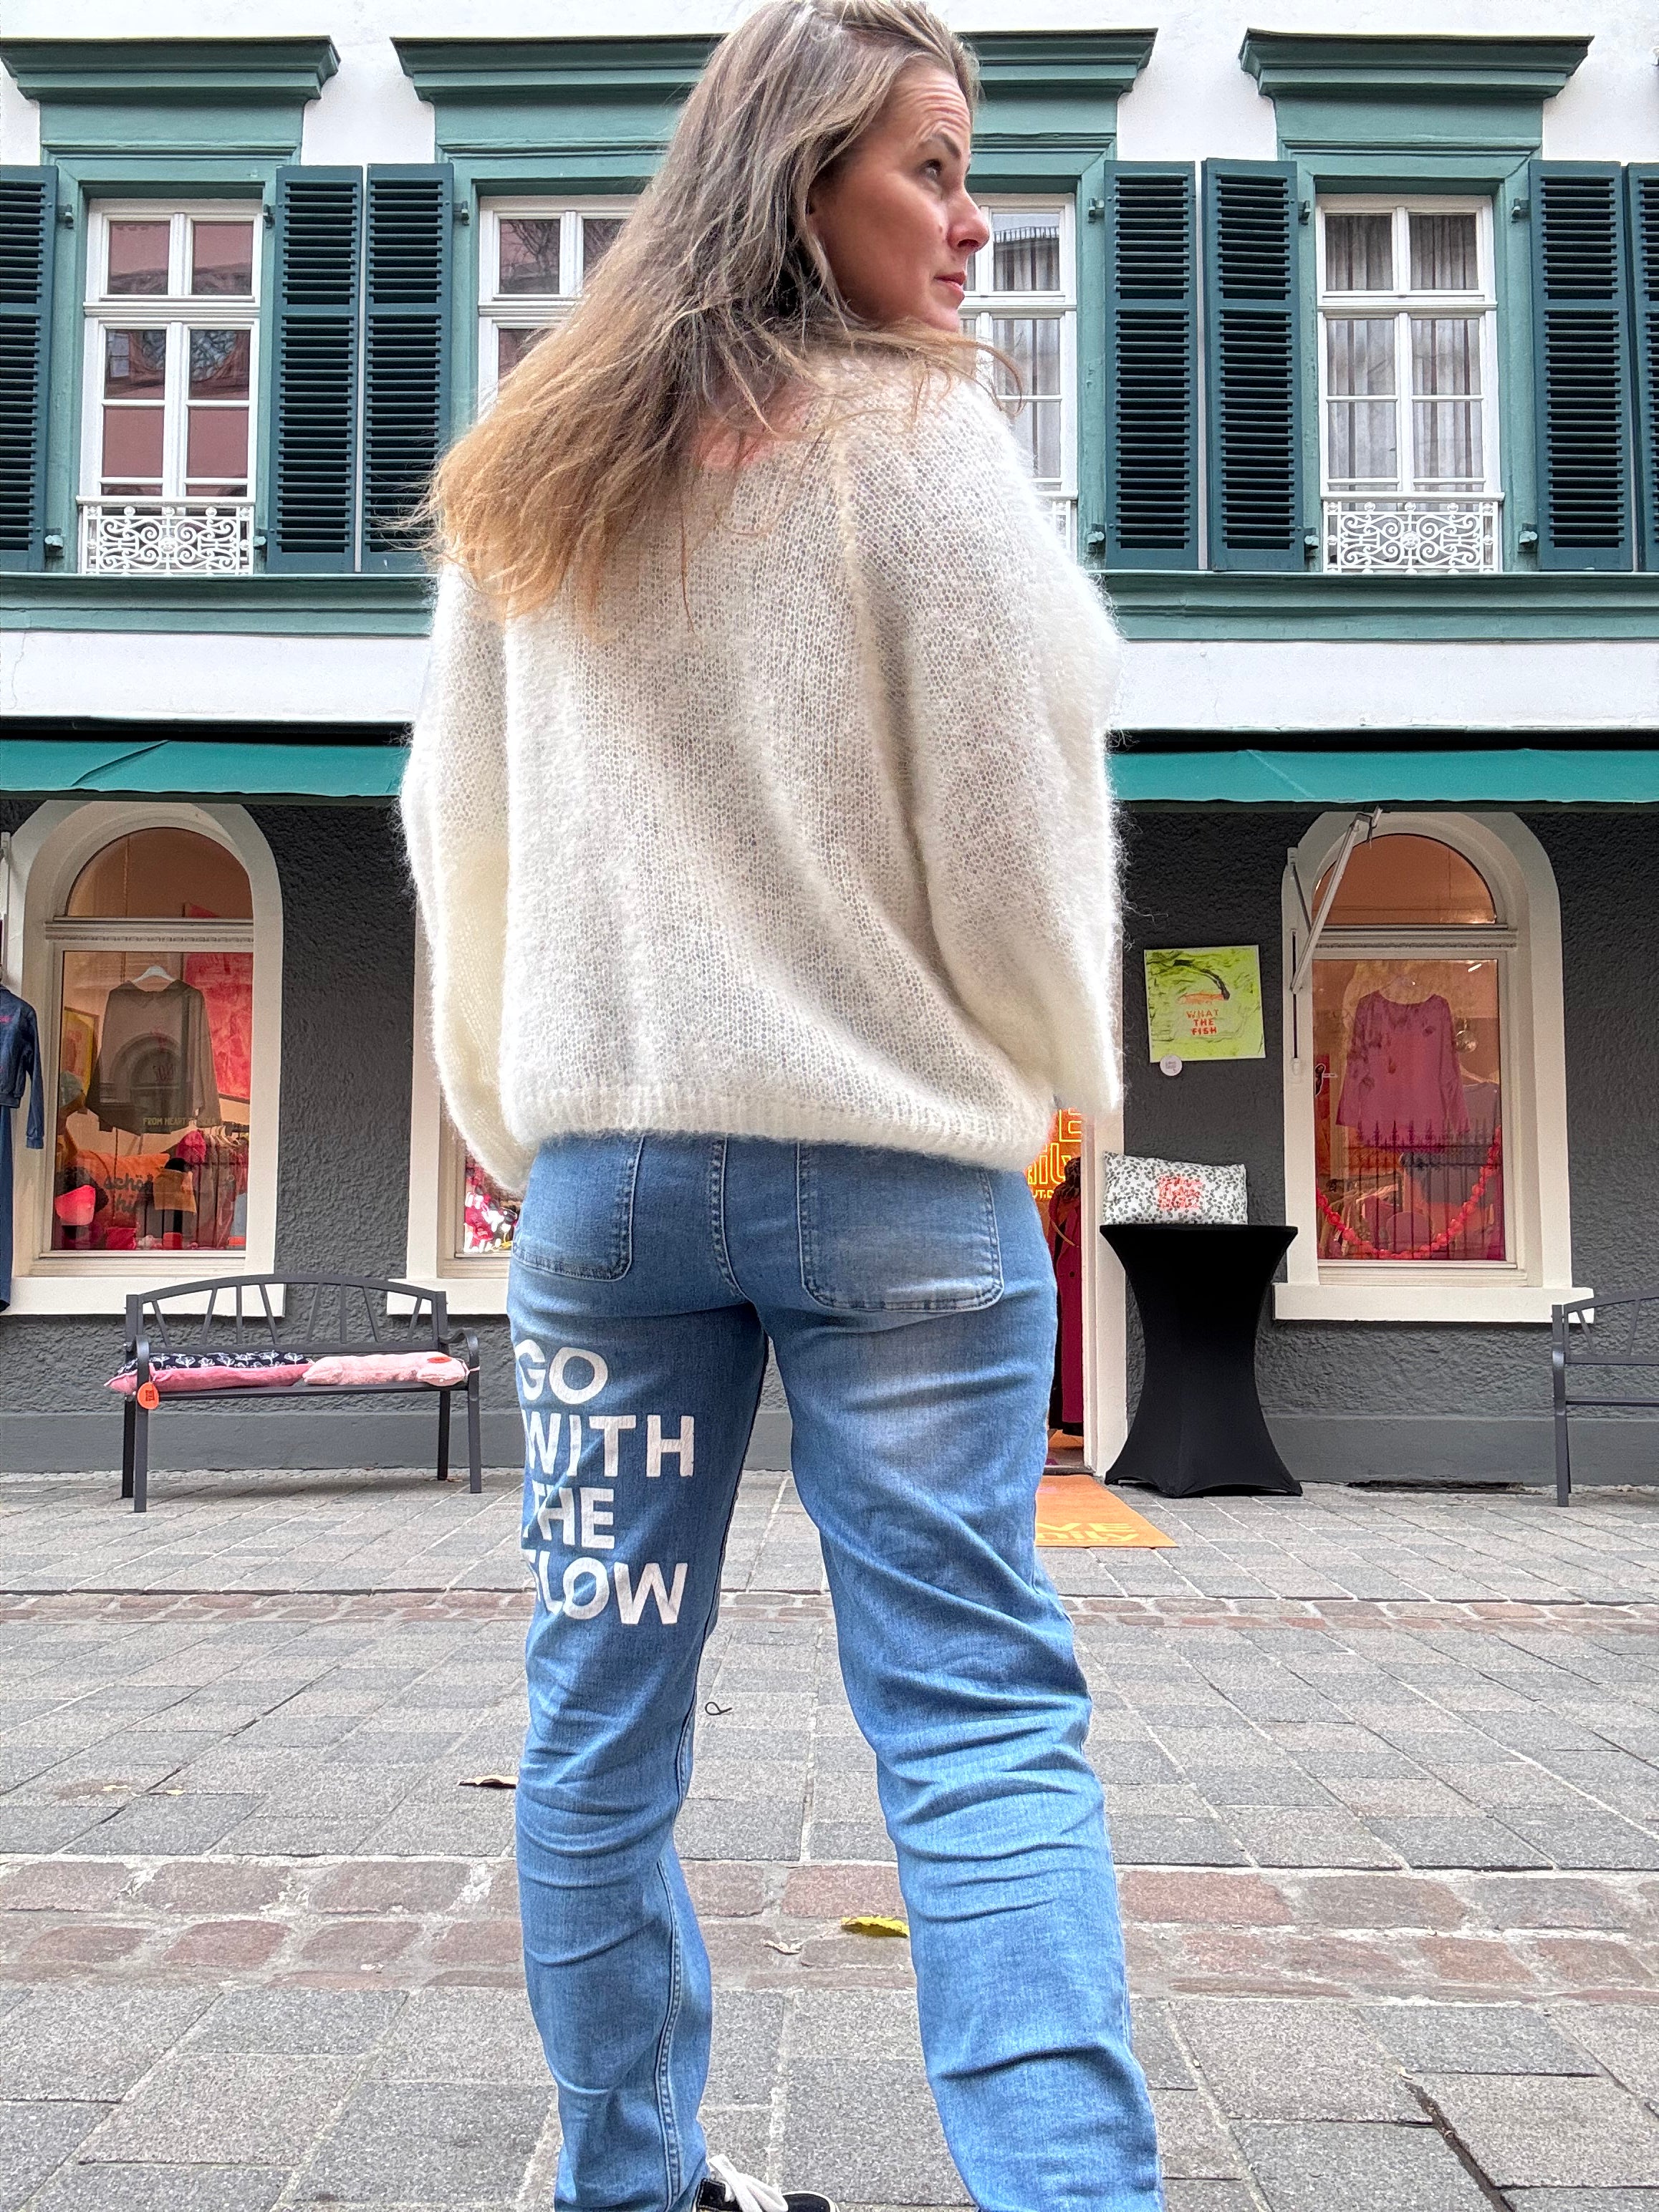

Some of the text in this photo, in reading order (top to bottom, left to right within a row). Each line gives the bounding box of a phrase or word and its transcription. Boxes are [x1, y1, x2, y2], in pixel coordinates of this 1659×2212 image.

[1186, 1009, 1219, 1019] WHAT
[1193, 1018, 1214, 1026] THE
[1191, 1026, 1217, 1035] FISH
[514, 1339, 608, 1405] GO
[521, 1408, 695, 1478] WITH
